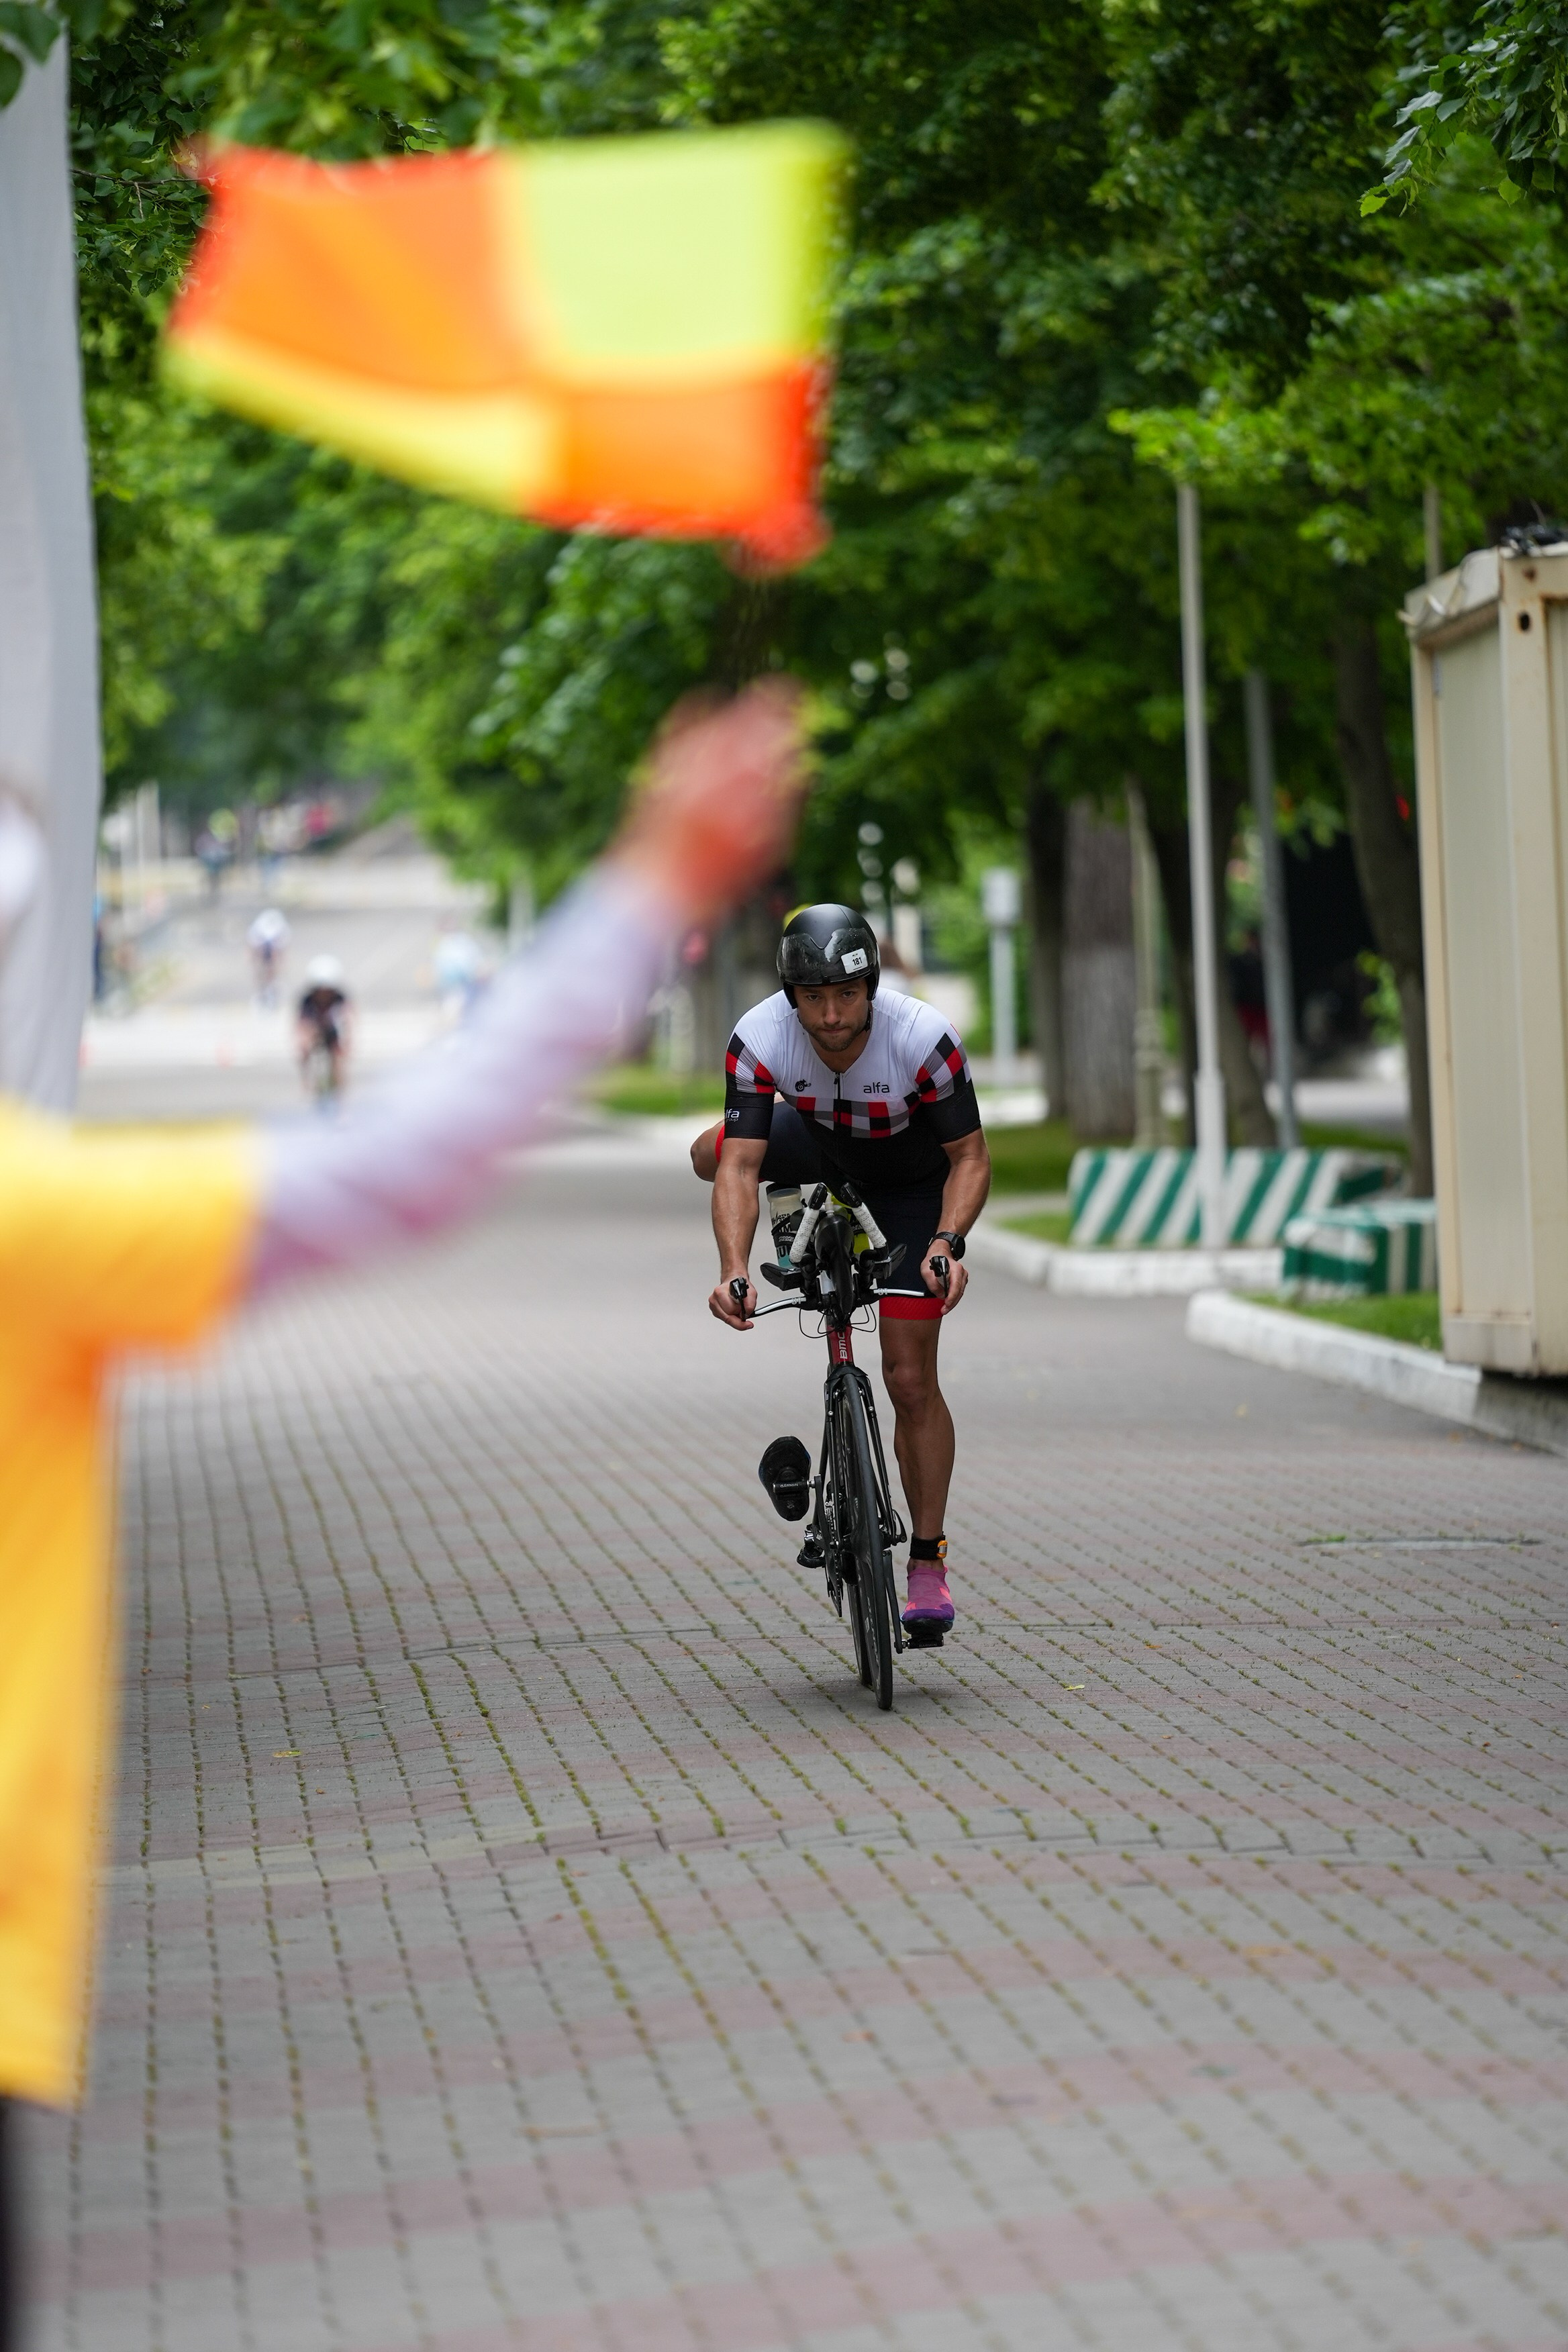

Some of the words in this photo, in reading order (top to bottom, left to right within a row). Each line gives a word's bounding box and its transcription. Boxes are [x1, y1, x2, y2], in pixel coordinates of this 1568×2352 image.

[852, 957, 862, 965] 181
[863, 1081, 890, 1093] alfa
[725, 1108, 740, 1118] lfa
[837, 1332, 848, 1359] BMC
